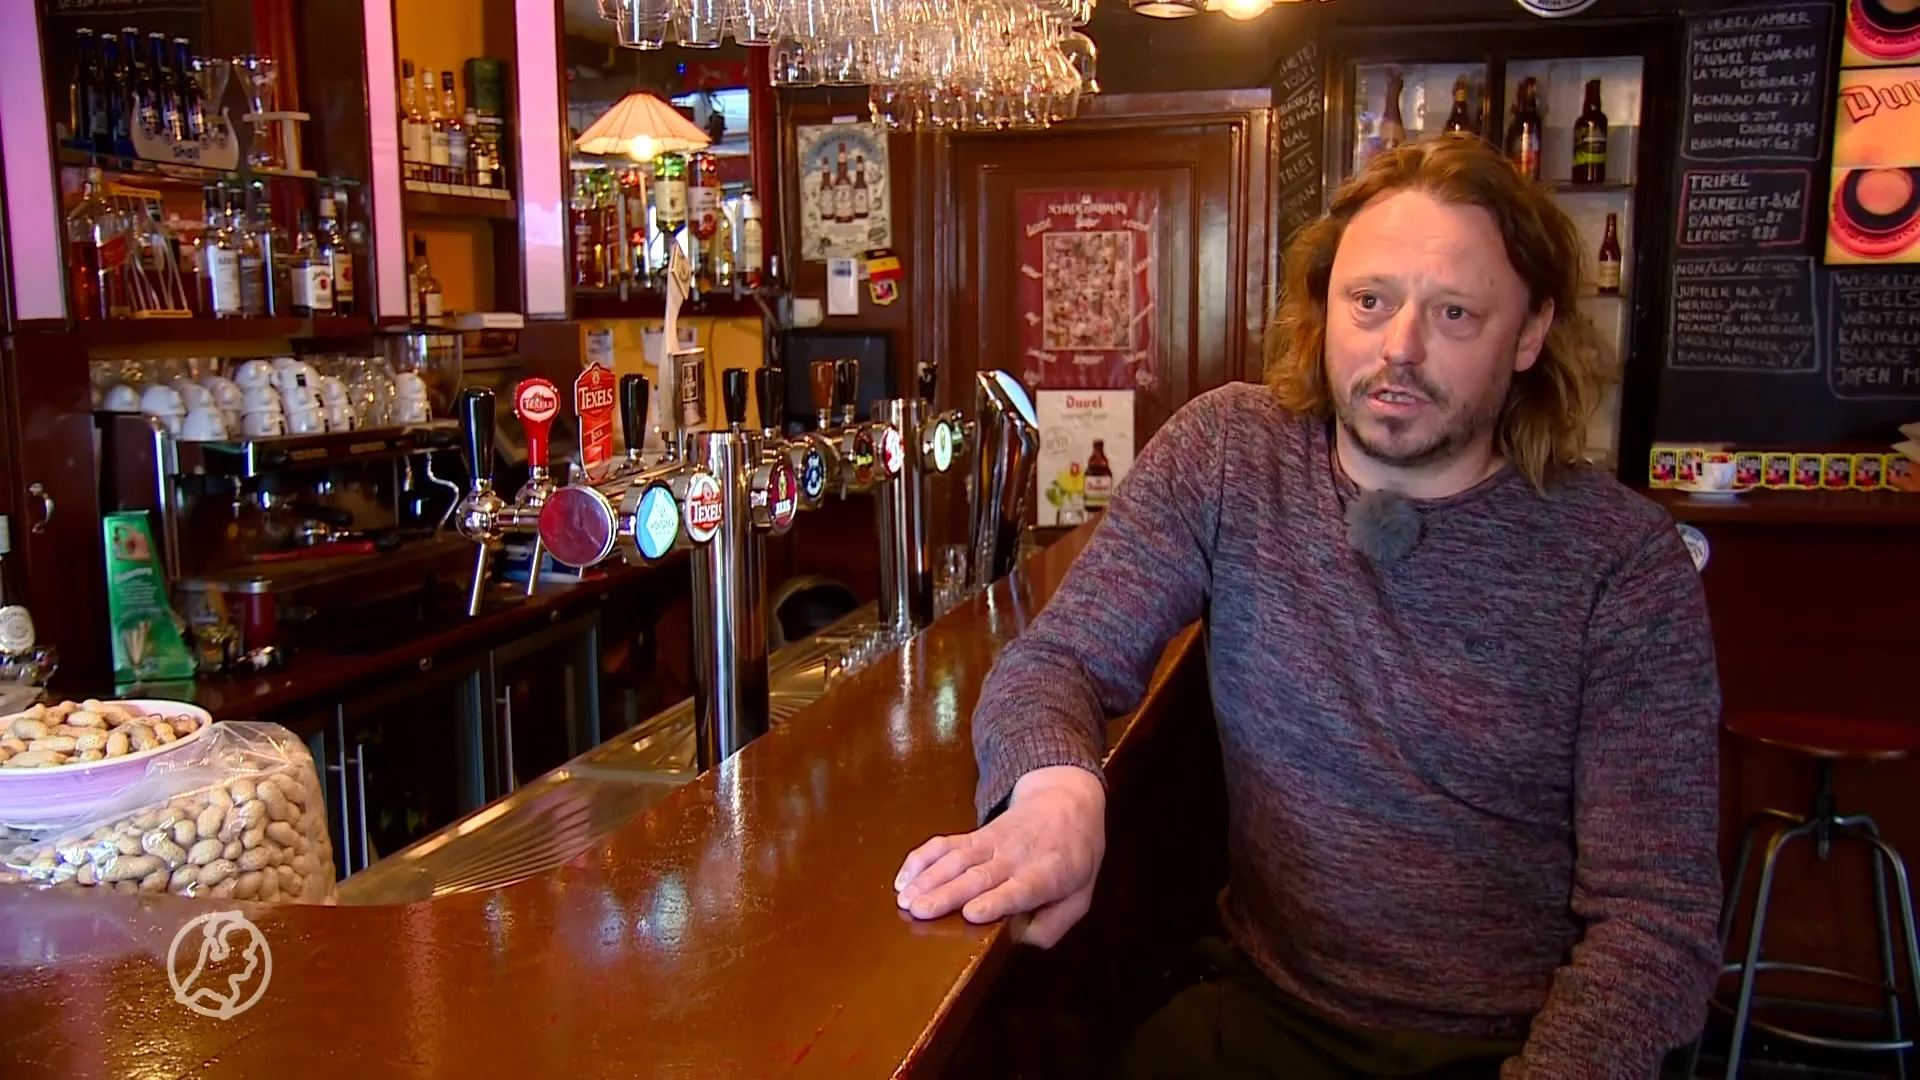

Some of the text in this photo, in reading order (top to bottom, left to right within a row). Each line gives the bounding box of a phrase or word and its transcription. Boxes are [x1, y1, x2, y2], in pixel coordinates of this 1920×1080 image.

[1710, 65, 1768, 79] TRAPPE
[1692, 92, 1755, 106] KONRAD
[1688, 173, 1751, 190] TRIPEL
[579, 386, 613, 411] TEXELS
[1066, 395, 1103, 409] Duvel
